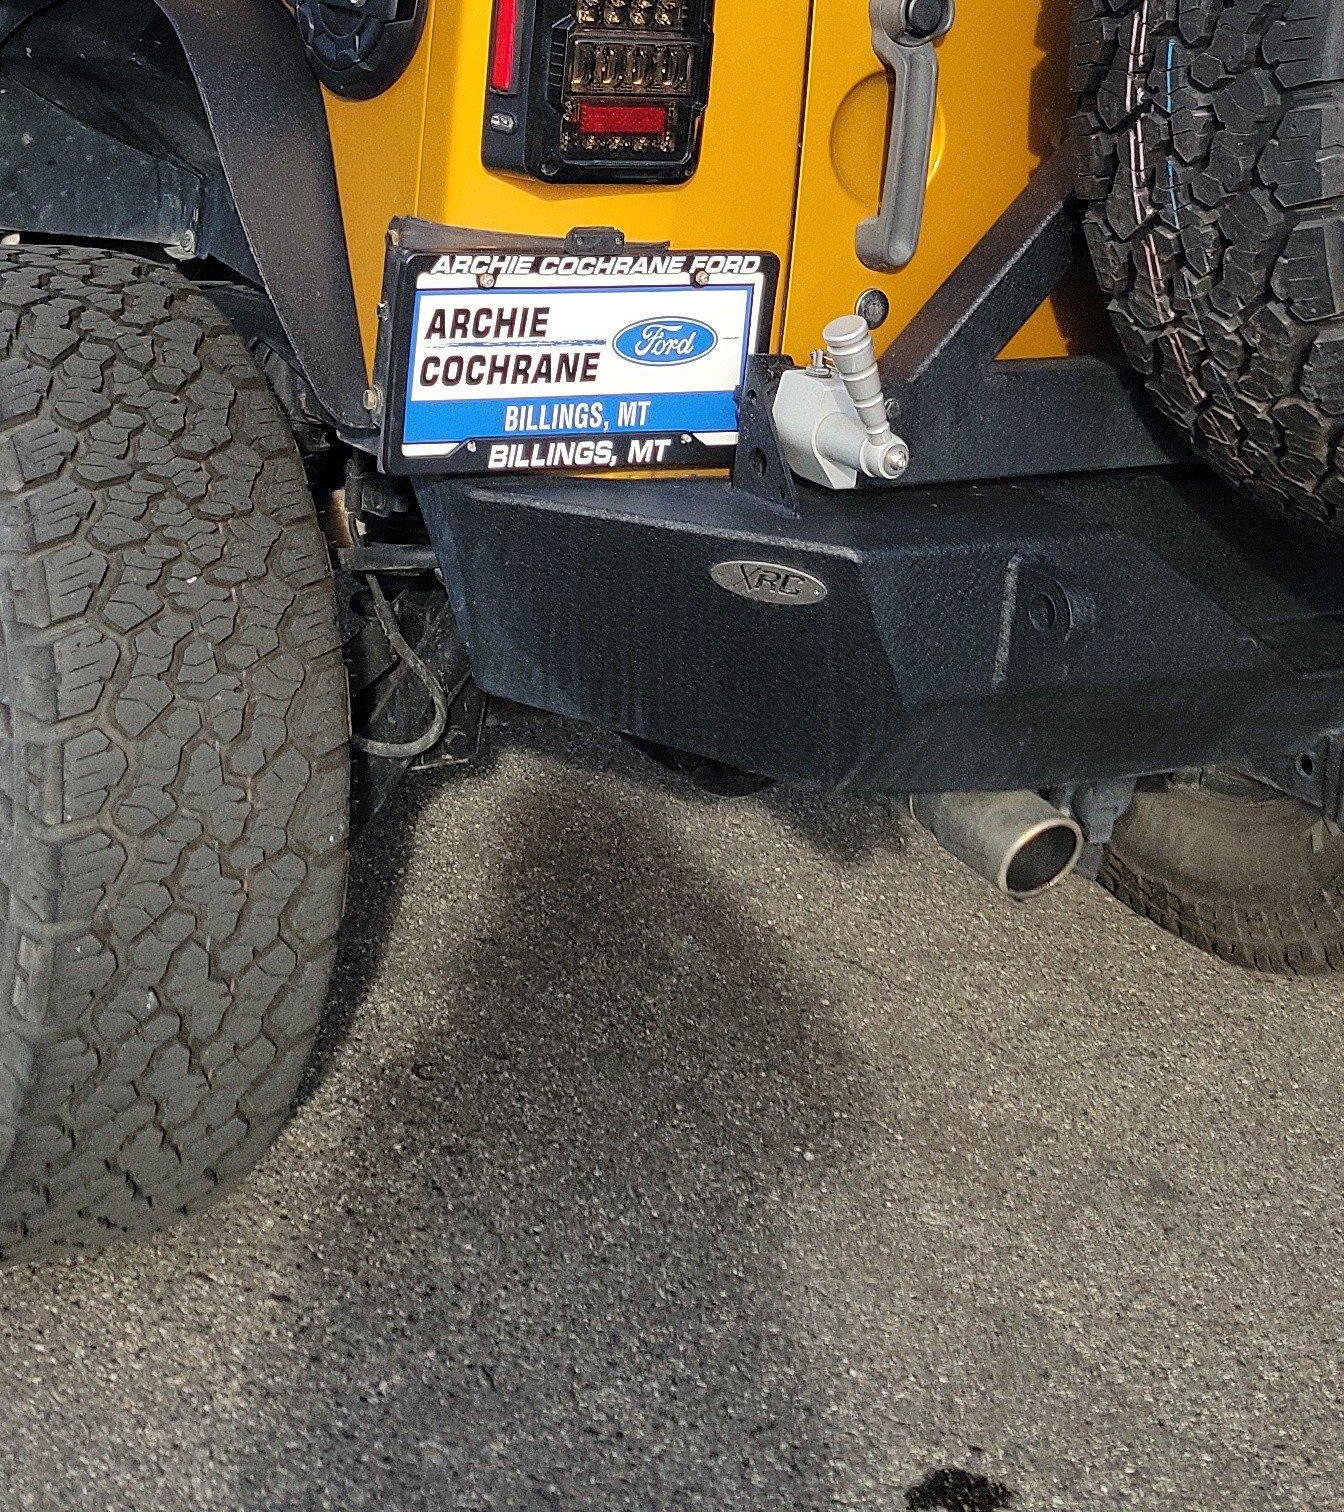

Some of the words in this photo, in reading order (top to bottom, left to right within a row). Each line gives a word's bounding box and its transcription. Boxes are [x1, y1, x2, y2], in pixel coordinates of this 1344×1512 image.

[431, 255, 535, 275] ARCHIE
[539, 255, 685, 275] COCHRANE
[689, 255, 761, 274] FORD
[424, 306, 550, 339] ARCHIE
[633, 323, 696, 356] Ford
[419, 352, 601, 386] COCHRANE
[504, 402, 610, 432] BILLINGS,
[616, 400, 651, 427] MT
[488, 441, 618, 470] BILLINGS,
[627, 439, 672, 463] MT
[732, 564, 806, 595] XRC
